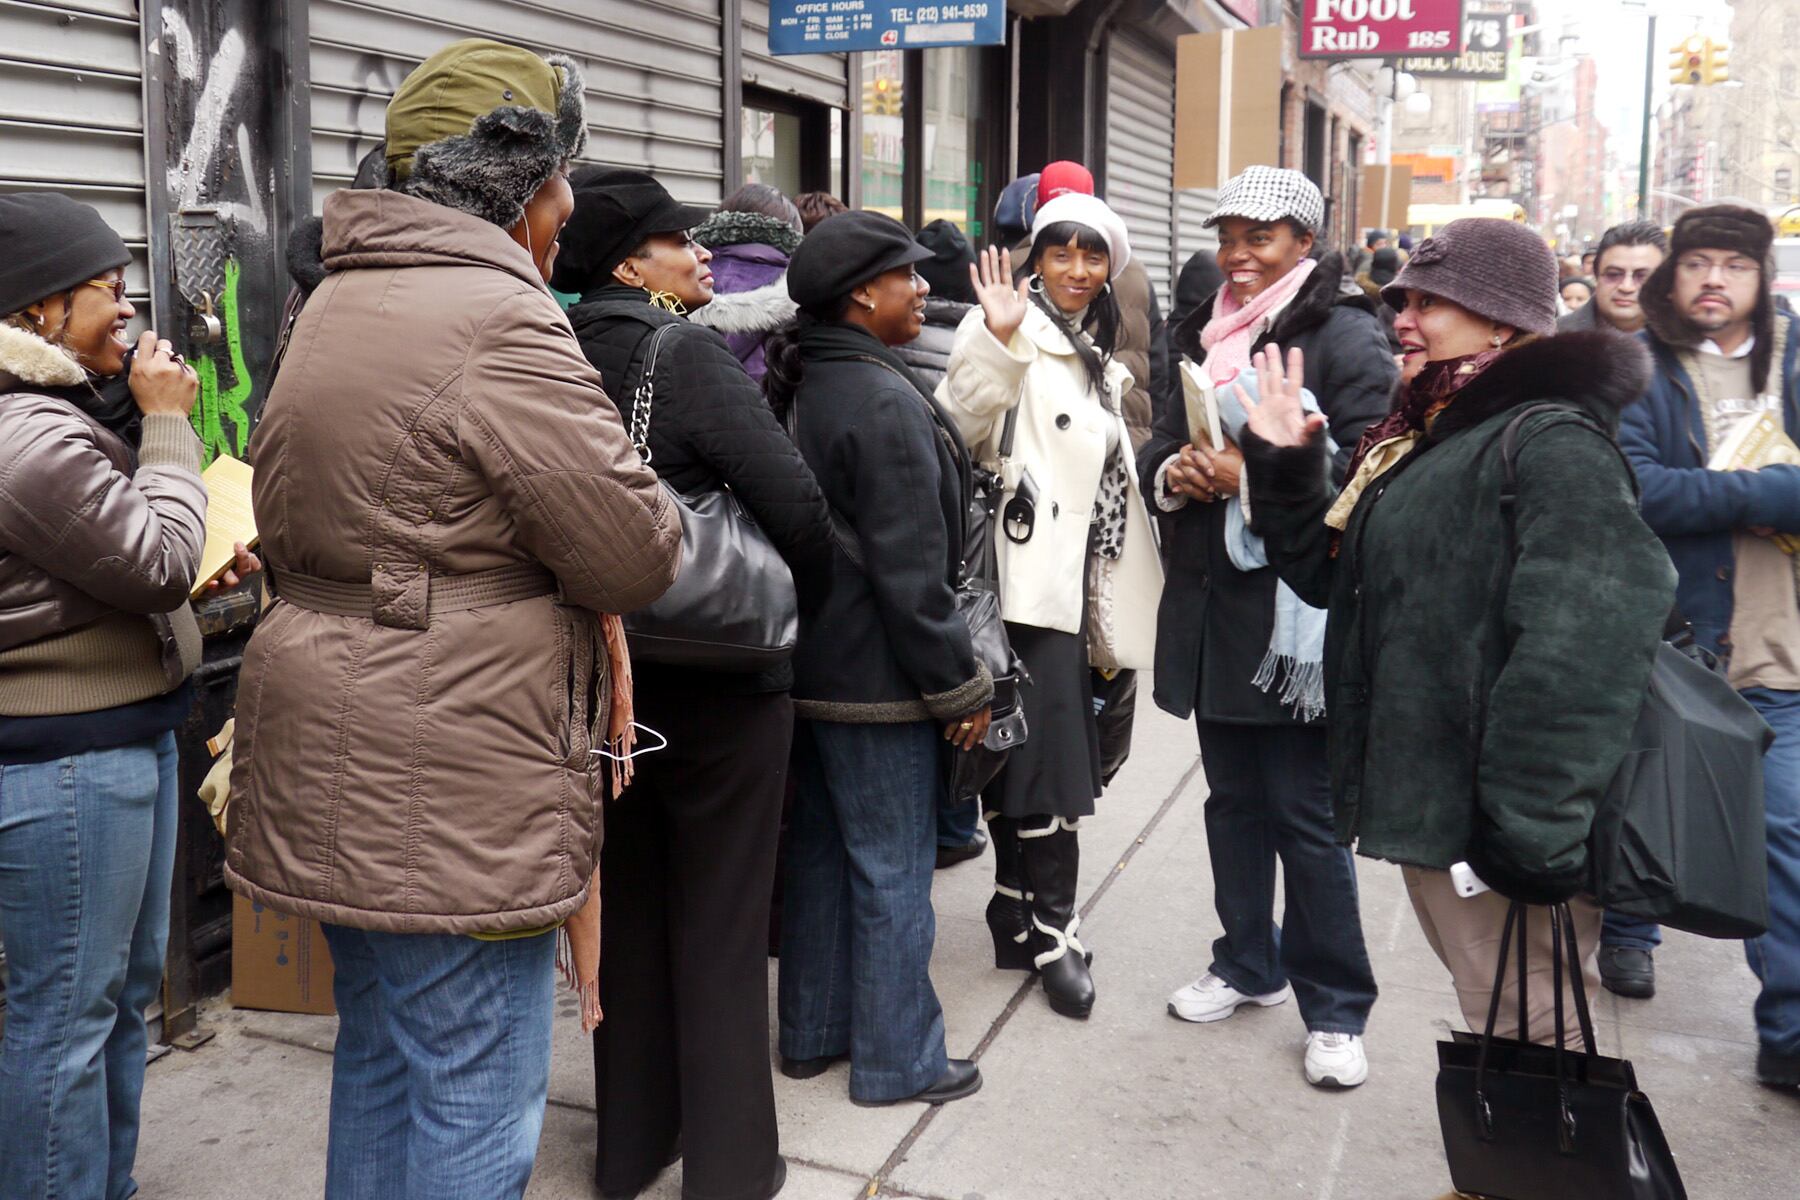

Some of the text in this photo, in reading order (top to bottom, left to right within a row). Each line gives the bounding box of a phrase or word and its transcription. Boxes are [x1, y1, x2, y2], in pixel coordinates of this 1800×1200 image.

[795, 1, 864, 14] OFFICE HOURS
[890, 3, 988, 24] TEL: (212) 941-8530
[1311, 0, 1417, 22] Foot
[781, 18, 798, 26] MON
[860, 13, 872, 21] PM
[860, 22, 872, 30] PM
[825, 31, 849, 40] CLOSE
[1311, 25, 1450, 51] Rub 185
[1453, 51, 1504, 73] HOUSE
